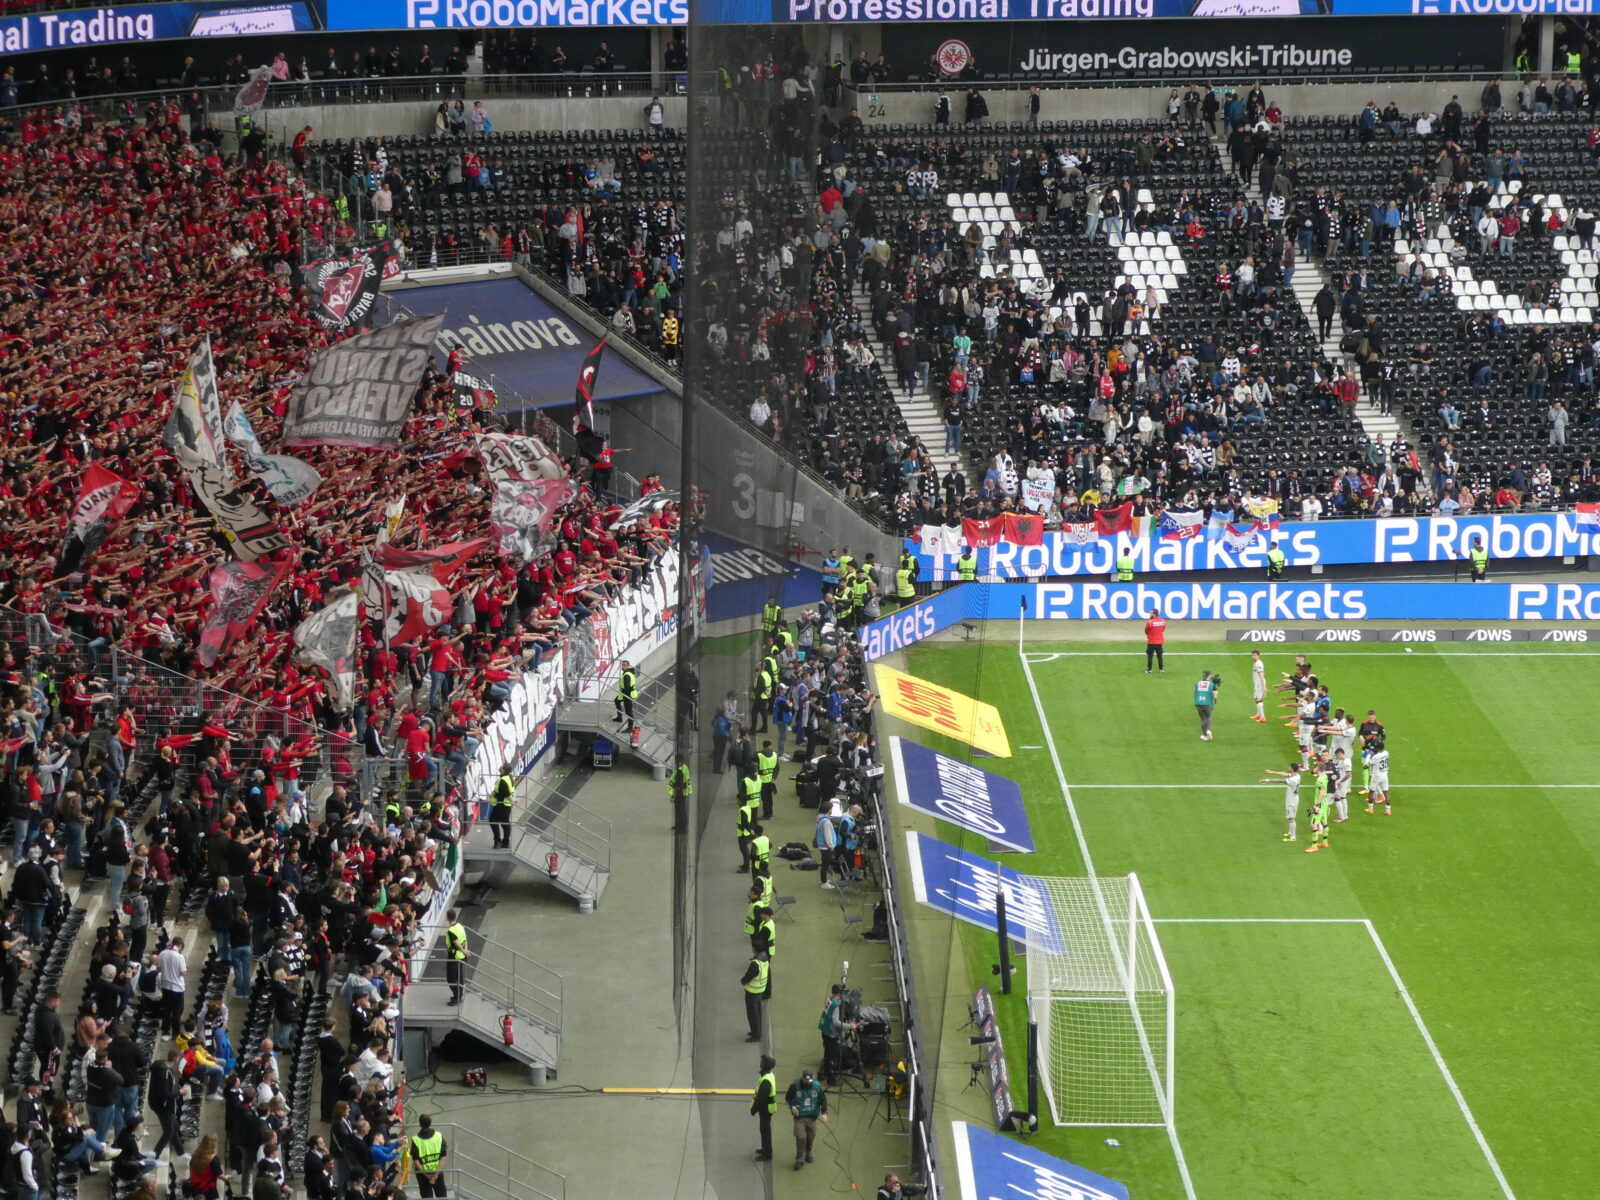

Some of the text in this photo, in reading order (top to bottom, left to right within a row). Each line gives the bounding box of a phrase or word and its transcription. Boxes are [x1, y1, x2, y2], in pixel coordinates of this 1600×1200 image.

[447, 0, 688, 27] RoboMarkets
[40, 10, 153, 48] Trading
[1021, 45, 1352, 73] Jürgen-Grabowski-Tribune
[869, 103, 885, 117] 24
[459, 395, 472, 406] 20
[731, 472, 757, 520] 3
[1176, 526, 1195, 539] 23
[1428, 515, 1600, 561] RoboM
[992, 526, 1321, 577] RoboMarkets
[1083, 583, 1366, 619] RoboMarkets
[1251, 629, 1285, 642] DWS
[1325, 629, 1361, 642] DWS
[1401, 629, 1436, 642] DWS
[1477, 629, 1512, 642] DWS
[1553, 629, 1587, 642] DWS
[935, 753, 993, 815] HYUNDAI
